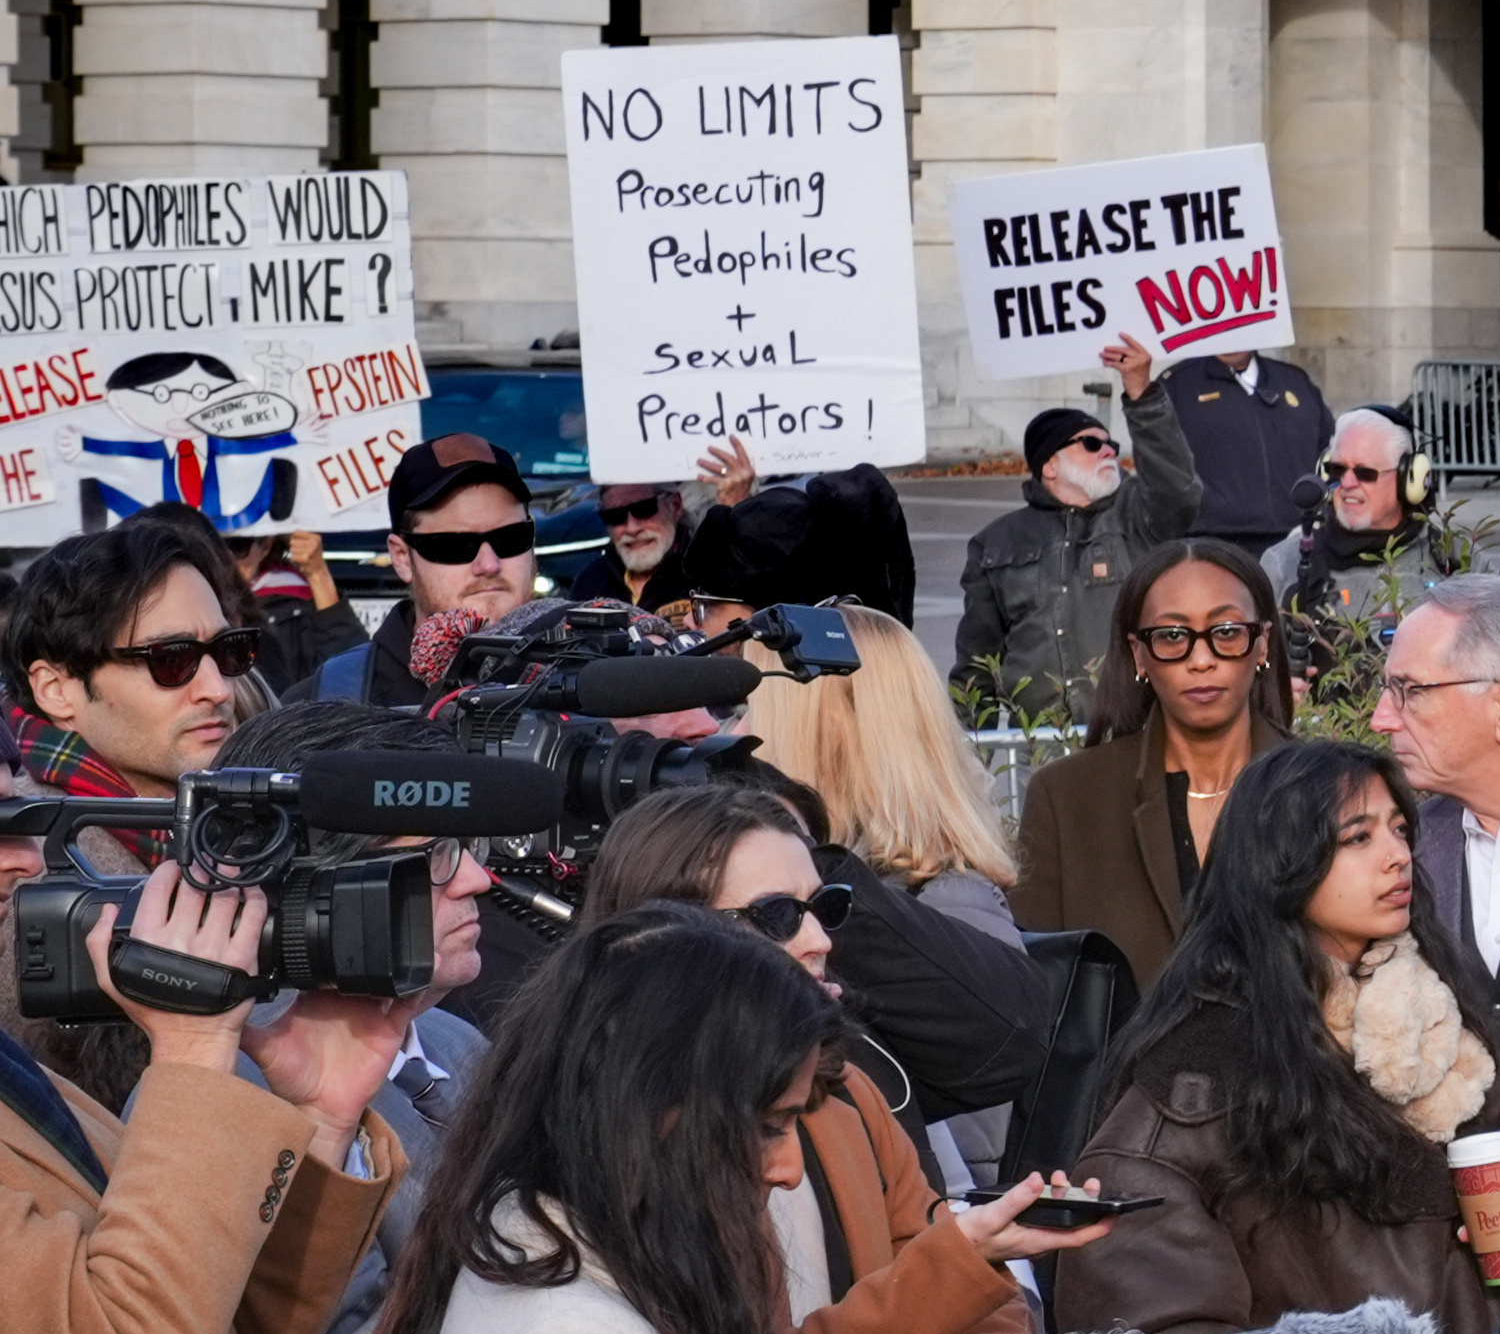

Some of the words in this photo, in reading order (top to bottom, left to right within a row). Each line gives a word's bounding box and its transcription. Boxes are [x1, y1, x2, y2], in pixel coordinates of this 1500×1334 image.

[583, 88, 662, 141] NO
[700, 79, 882, 137] LIMITS
[86, 182, 247, 251] PEDOPHILES
[268, 176, 388, 242] WOULD
[617, 169, 824, 218] Prosecuting
[983, 199, 1156, 268] RELEASE
[1160, 186, 1245, 245] THE
[649, 230, 857, 285] Pedophiles
[994, 278, 1107, 339] FILES
[1135, 247, 1278, 334] NOW!
[0, 348, 102, 424] LEASE
[201, 399, 247, 421] NOTHING
[255, 395, 270, 406] TO
[307, 344, 421, 420] EPSTEIN
[211, 419, 234, 434] SEE
[374, 780, 470, 809] RØDE
[141, 967, 199, 992] SONY
